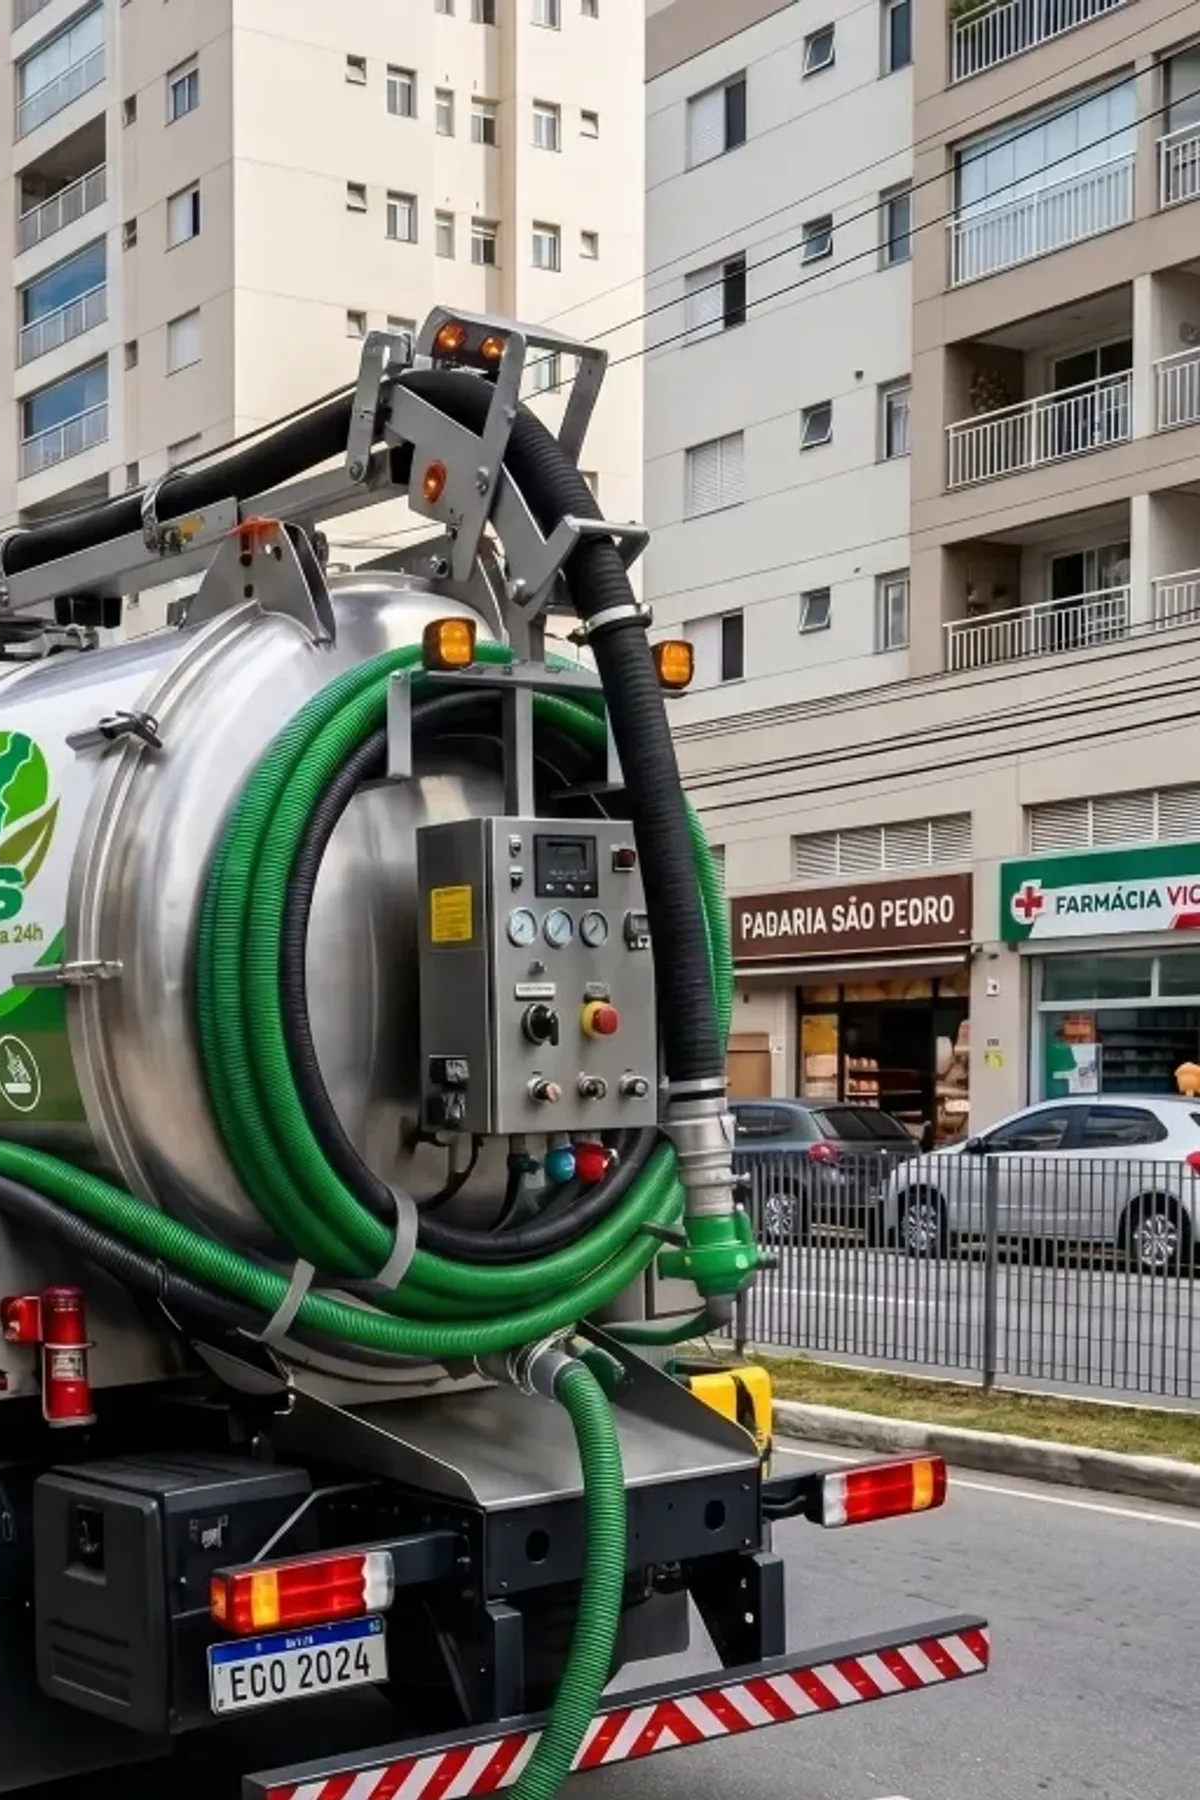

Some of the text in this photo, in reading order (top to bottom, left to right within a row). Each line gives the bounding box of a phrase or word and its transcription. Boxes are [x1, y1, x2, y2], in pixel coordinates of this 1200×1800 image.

[741, 907, 828, 940] PADARIA
[880, 894, 955, 928] PEDRO
[1056, 885, 1162, 915] FARMÁCIA
[13, 922, 44, 944] 24h
[297, 1642, 371, 1690] 2024
